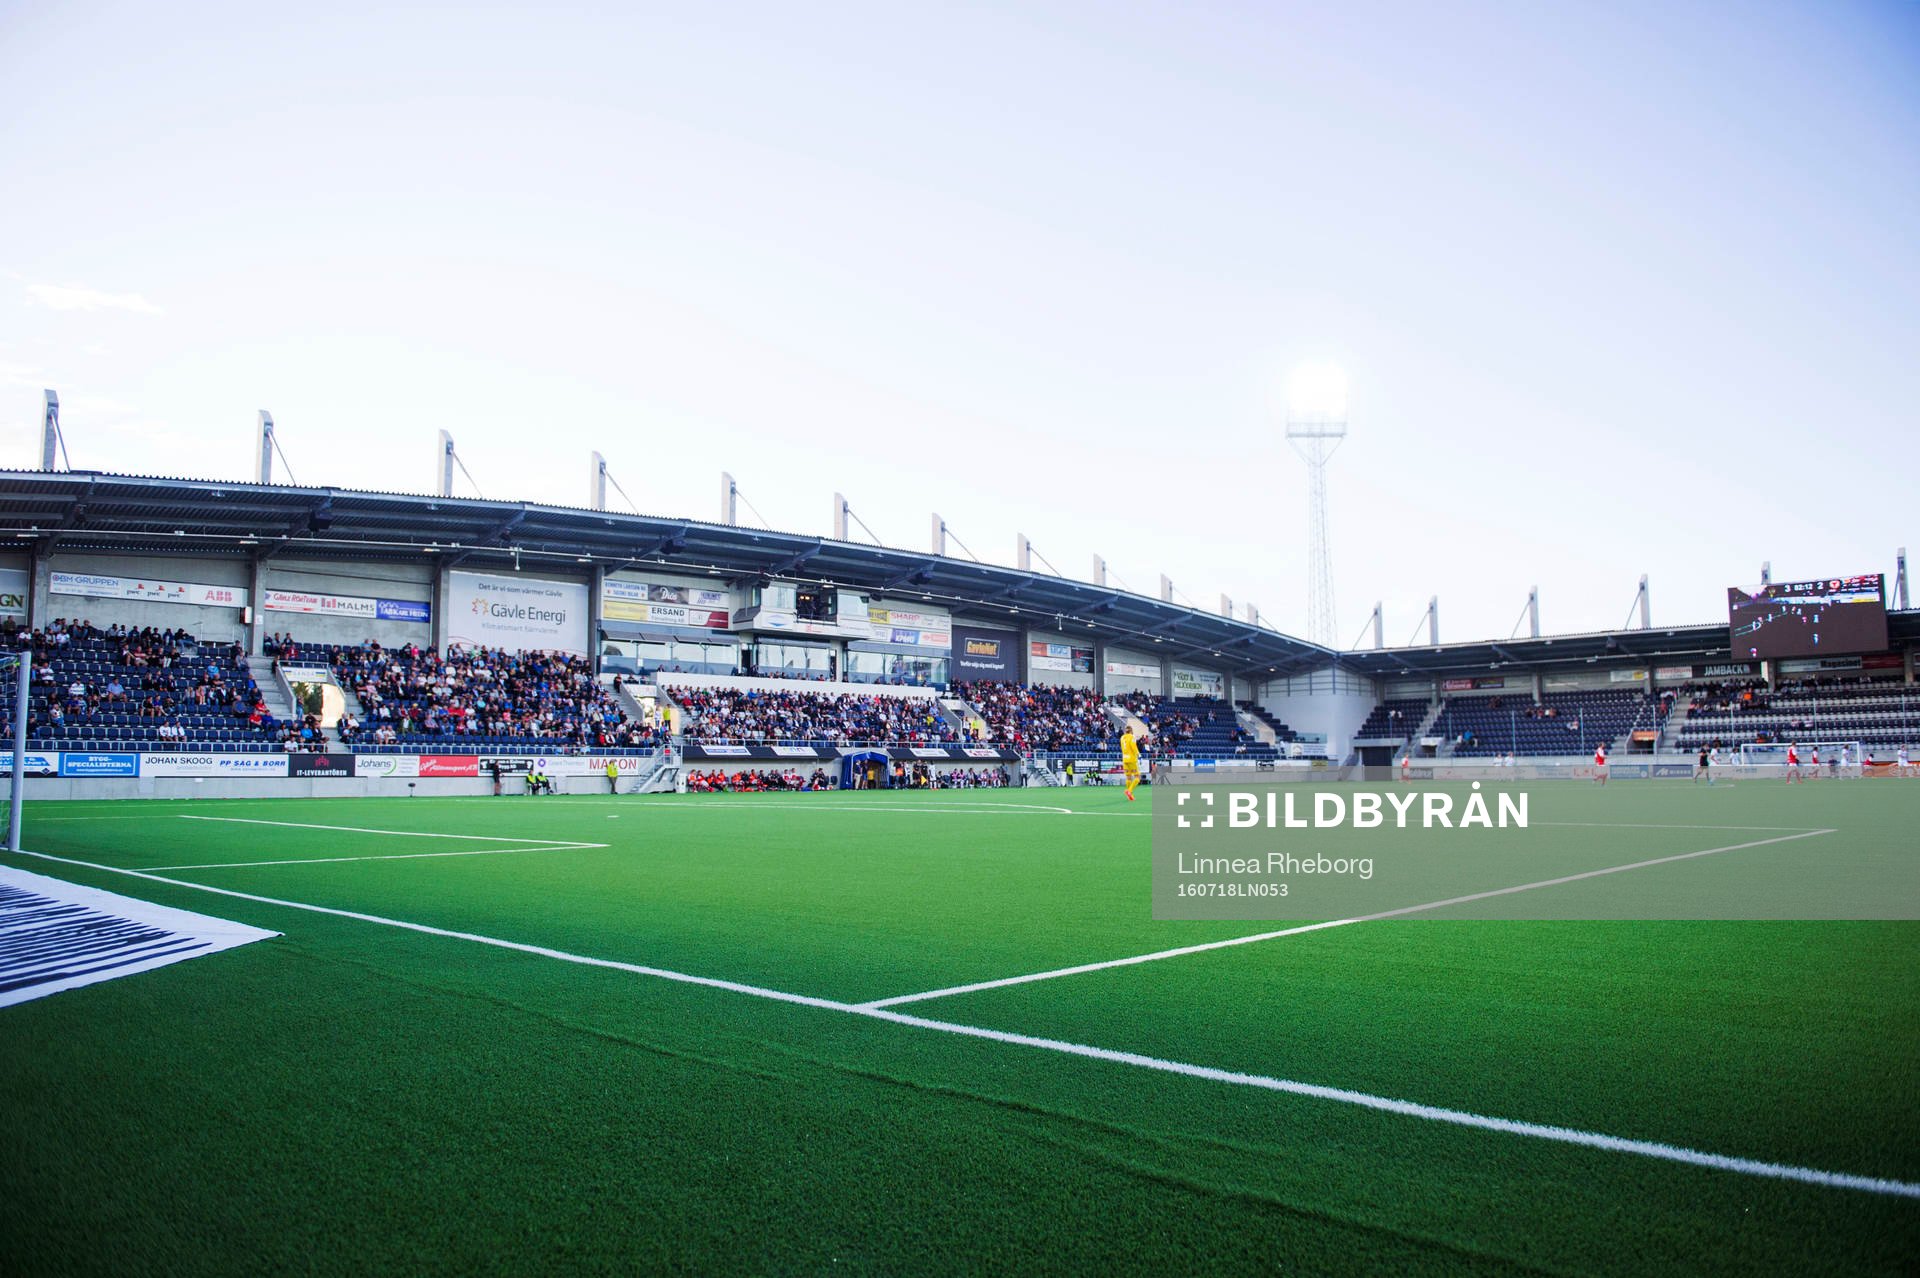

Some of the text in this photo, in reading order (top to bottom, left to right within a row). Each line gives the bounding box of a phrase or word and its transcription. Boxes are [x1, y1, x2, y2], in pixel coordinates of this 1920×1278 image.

[1817, 582, 1824, 590] 2
[205, 590, 232, 602] ABB
[338, 602, 374, 612] MALMS
[652, 607, 684, 616] ERSAND
[491, 604, 566, 626] Gävle Energi
[1704, 665, 1743, 676] JAMBACK
[146, 756, 213, 765] JOHAN SKOOG
[357, 759, 392, 768] Johans
[589, 758, 637, 770] MAON
